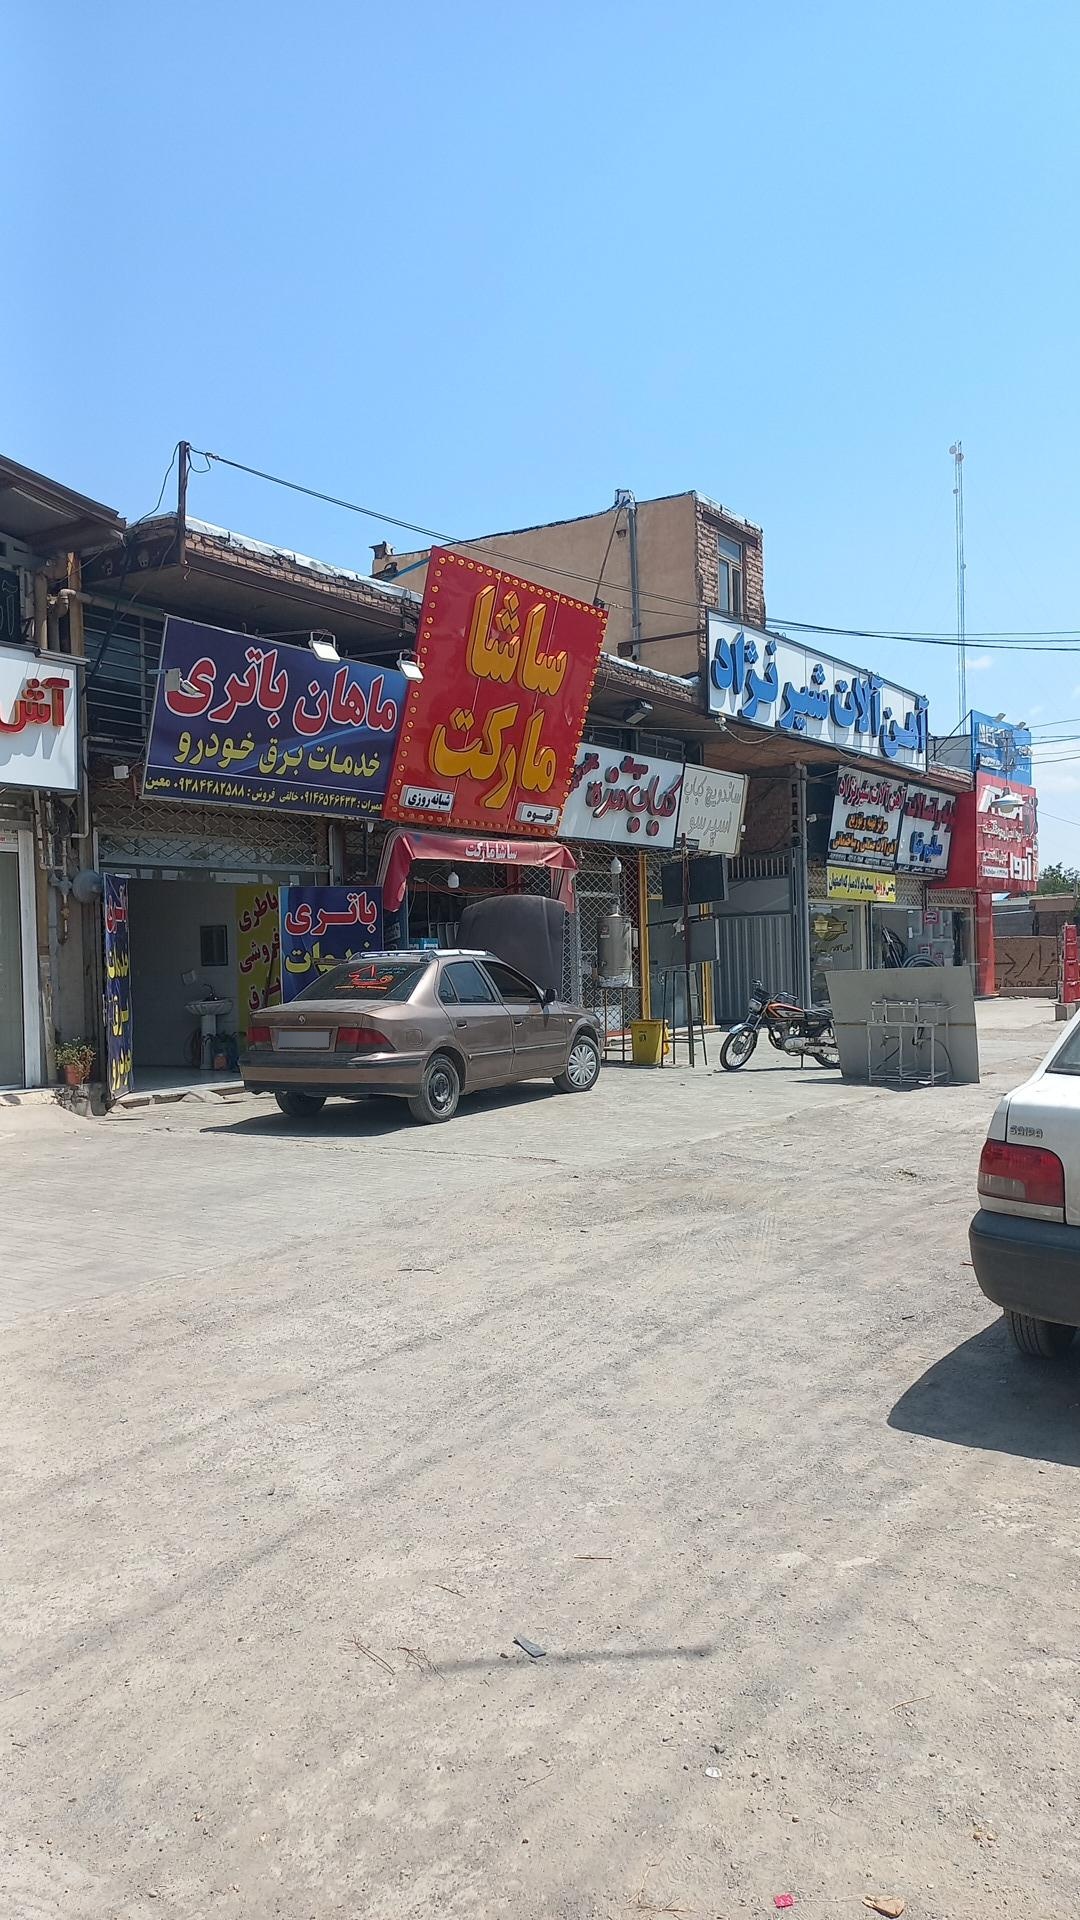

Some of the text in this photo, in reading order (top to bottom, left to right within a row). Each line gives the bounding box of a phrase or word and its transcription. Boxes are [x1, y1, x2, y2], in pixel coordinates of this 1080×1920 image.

[466, 585, 568, 696] ساشا
[165, 647, 397, 736] ماهان باتری
[830, 675, 884, 737] آلات
[880, 697, 929, 758] آهن
[173, 731, 381, 777] خدمات برق خودرو
[429, 702, 557, 809] مارکت
[626, 774, 684, 836] کباب
[684, 776, 741, 807] ساندویچ کباب
[464, 841, 518, 861] ساشا مارکت
[687, 811, 732, 847] اسپرسو
[239, 890, 278, 933] باطری
[285, 891, 377, 935] باتری
[240, 927, 280, 973] فروشی
